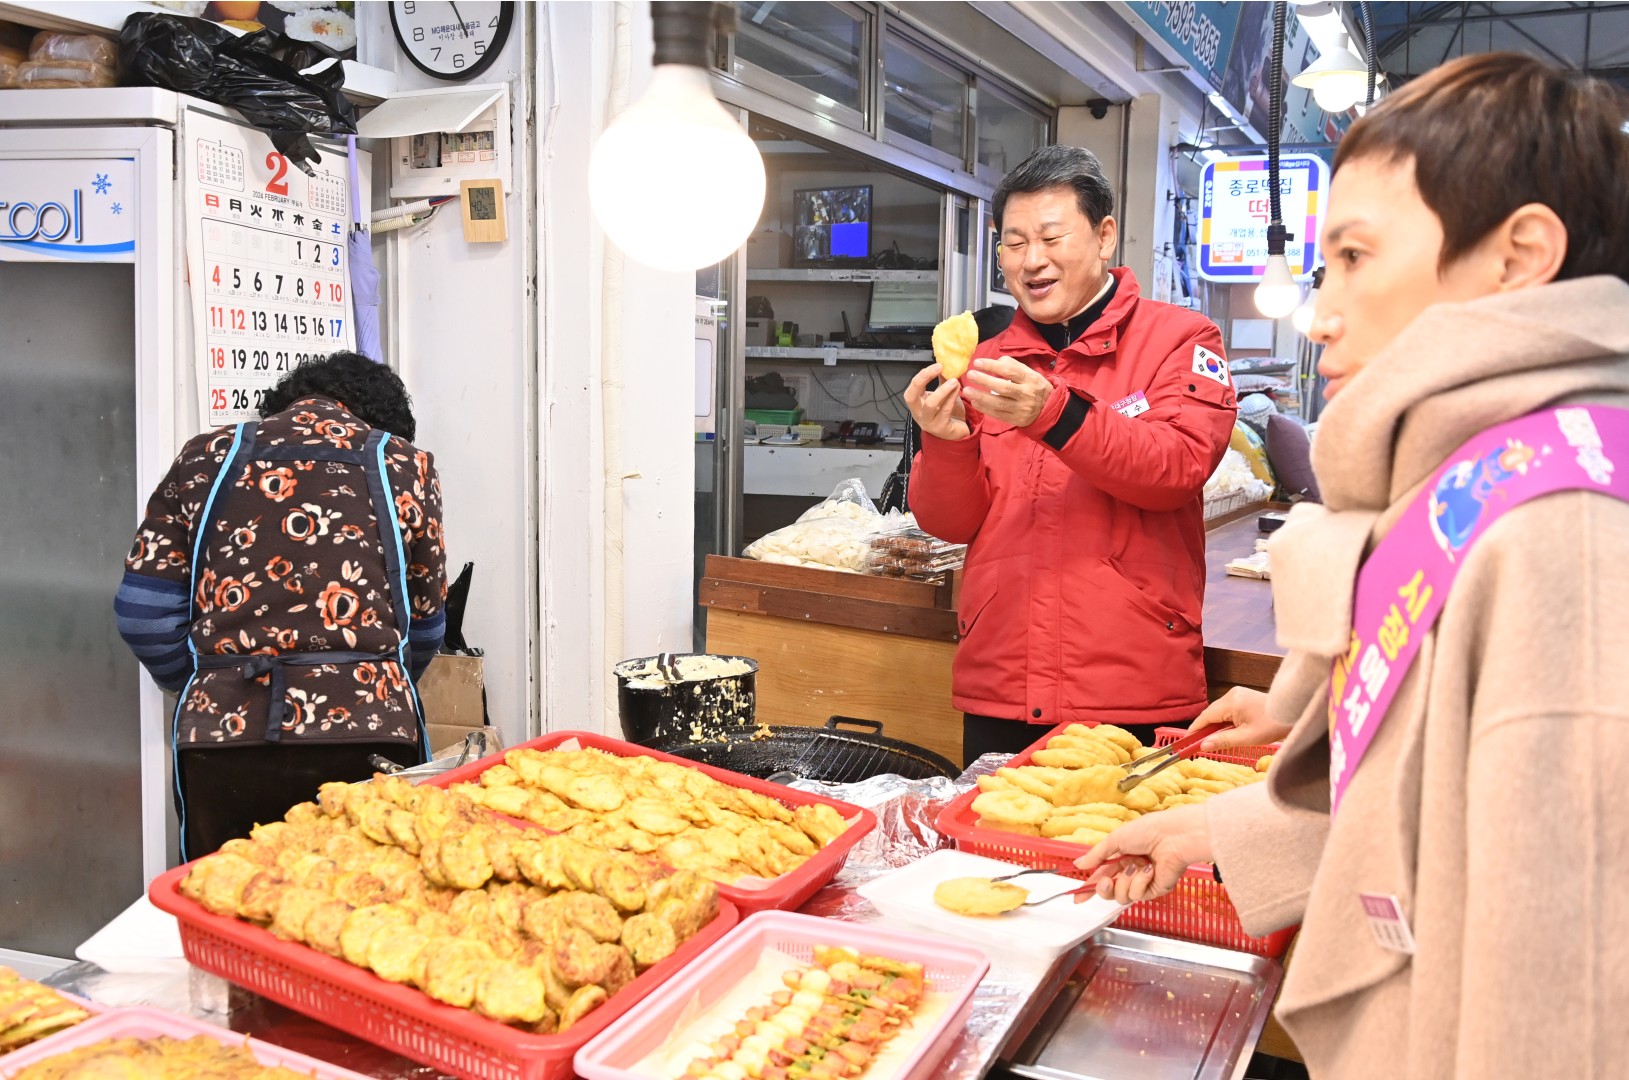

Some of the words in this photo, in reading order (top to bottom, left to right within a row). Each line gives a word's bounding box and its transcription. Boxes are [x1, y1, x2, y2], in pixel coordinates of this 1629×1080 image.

[404, 1, 416, 14] 9
[488, 16, 499, 28] 4
[412, 27, 424, 42] 8
[430, 46, 442, 62] 7
[474, 40, 486, 56] 5
[452, 54, 464, 68] 6
[266, 152, 288, 196] 2
[252, 190, 264, 198] 2024
[264, 194, 290, 204] FEBRUARY
[206, 194, 220, 208] 日
[230, 199, 242, 212] 月
[250, 204, 262, 218] 火
[294, 214, 304, 226] 木
[312, 218, 322, 232] 金
[331, 223, 341, 234] 土
[297, 241, 302, 260] 1
[314, 244, 320, 263] 2
[332, 248, 339, 266] 3
[212, 266, 220, 286] 4
[234, 268, 241, 288] 5
[254, 272, 262, 292] 6
[276, 275, 283, 294] 7
[296, 278, 304, 296] 8
[314, 281, 321, 300] 9
[330, 284, 342, 302] 10
[210, 306, 223, 328] 11
[230, 309, 246, 330] 12
[252, 311, 267, 331] 13
[274, 314, 288, 333] 14
[294, 316, 308, 334] 15
[312, 318, 324, 336] 16
[330, 320, 342, 338] 17
[211, 348, 225, 368] 18
[232, 349, 246, 369] 19
[253, 350, 269, 370] 20
[276, 352, 289, 370] 21
[212, 389, 226, 410] 25
[232, 389, 248, 410] 26
